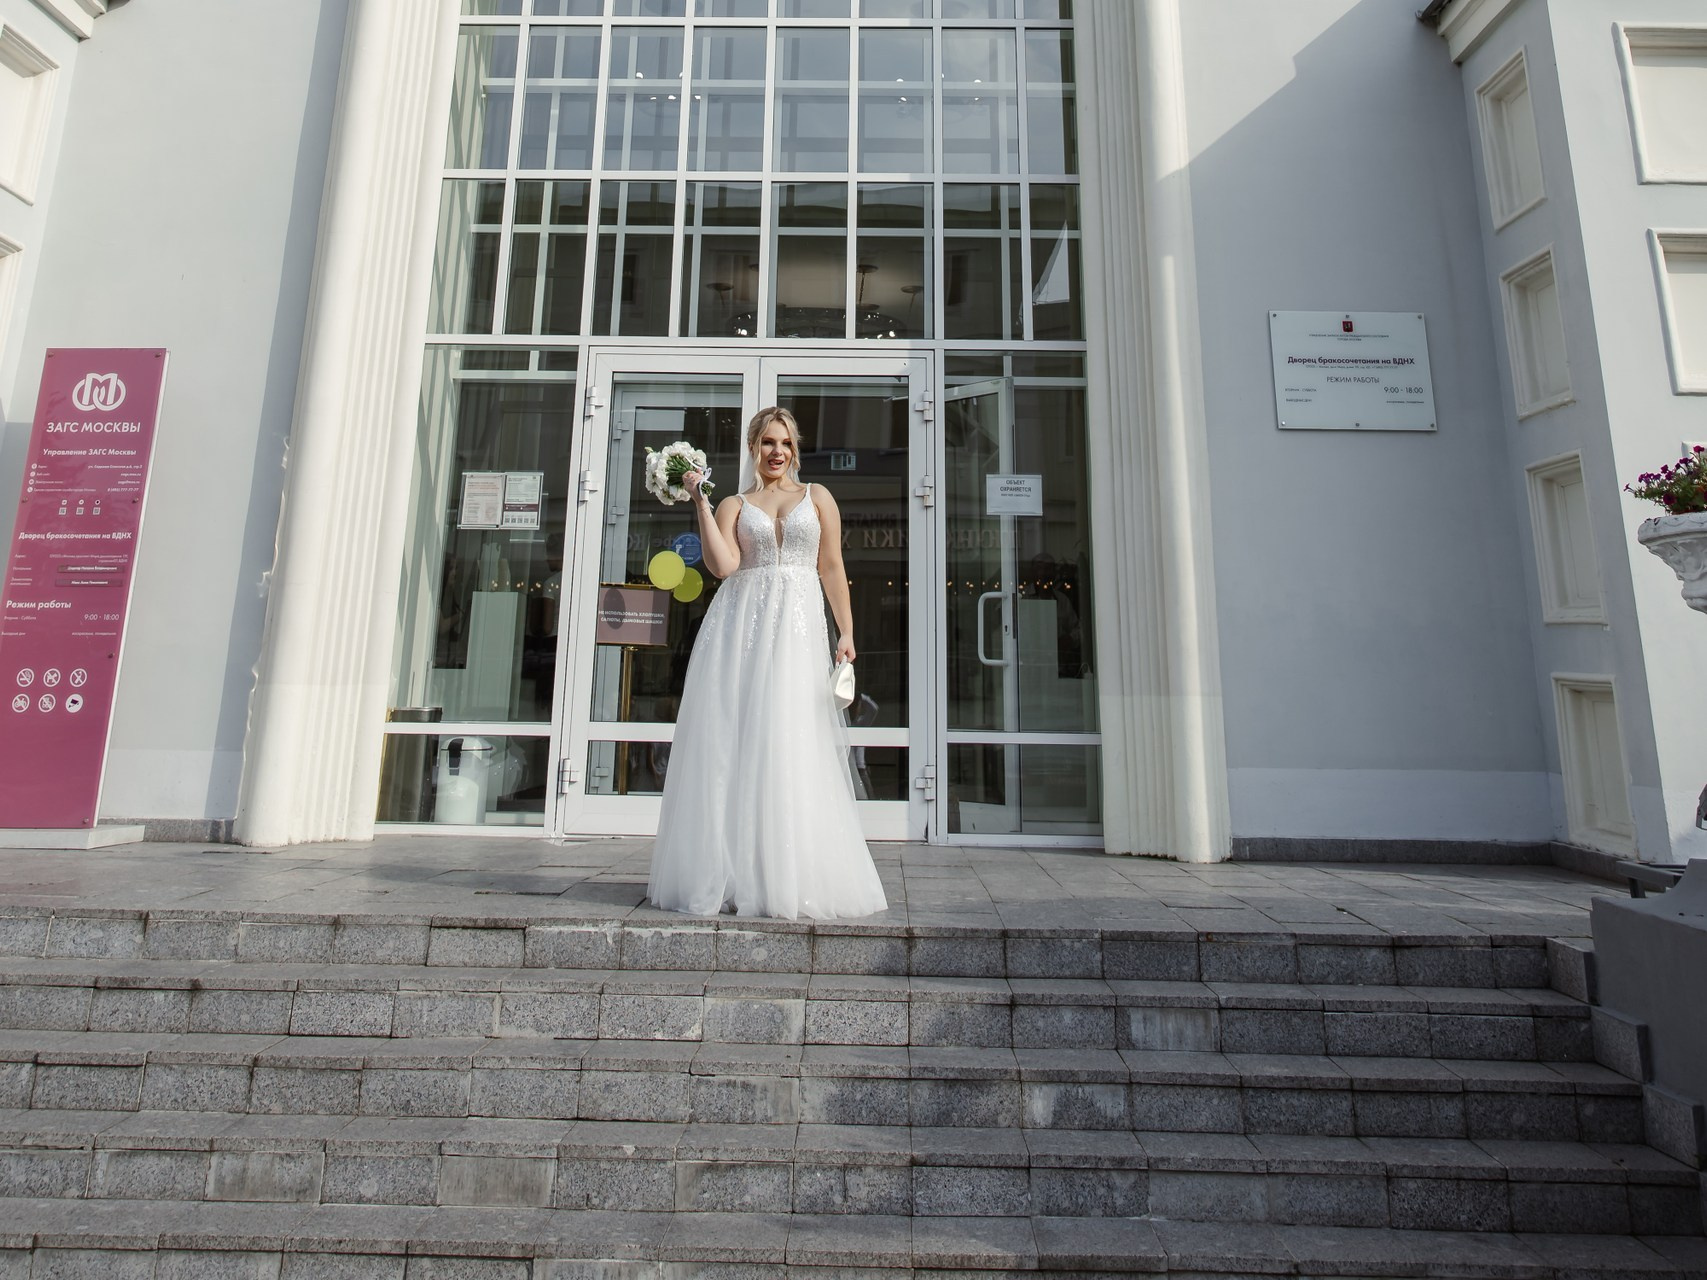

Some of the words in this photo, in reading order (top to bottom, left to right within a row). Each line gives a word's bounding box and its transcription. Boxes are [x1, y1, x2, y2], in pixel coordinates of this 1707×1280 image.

[1287, 356, 1317, 365] Дворец
[1318, 356, 1380, 365] бракосочетания
[1392, 357, 1415, 366] ВДНХ
[1353, 376, 1380, 384] РАБОТЫ
[1384, 386, 1399, 394] 9:00
[1405, 386, 1424, 394] 18:00
[46, 422, 79, 433] ЗАГС
[80, 422, 141, 433] МОСКВЫ
[43, 448, 86, 457] Управление
[88, 448, 107, 456] ЗАГС
[107, 448, 137, 456] Москвы
[18, 532, 46, 541] Дворец
[46, 531, 101, 541] бракосочетания
[111, 532, 132, 540] ВДНХ
[6, 600, 36, 608] Режим
[37, 599, 72, 611] работы
